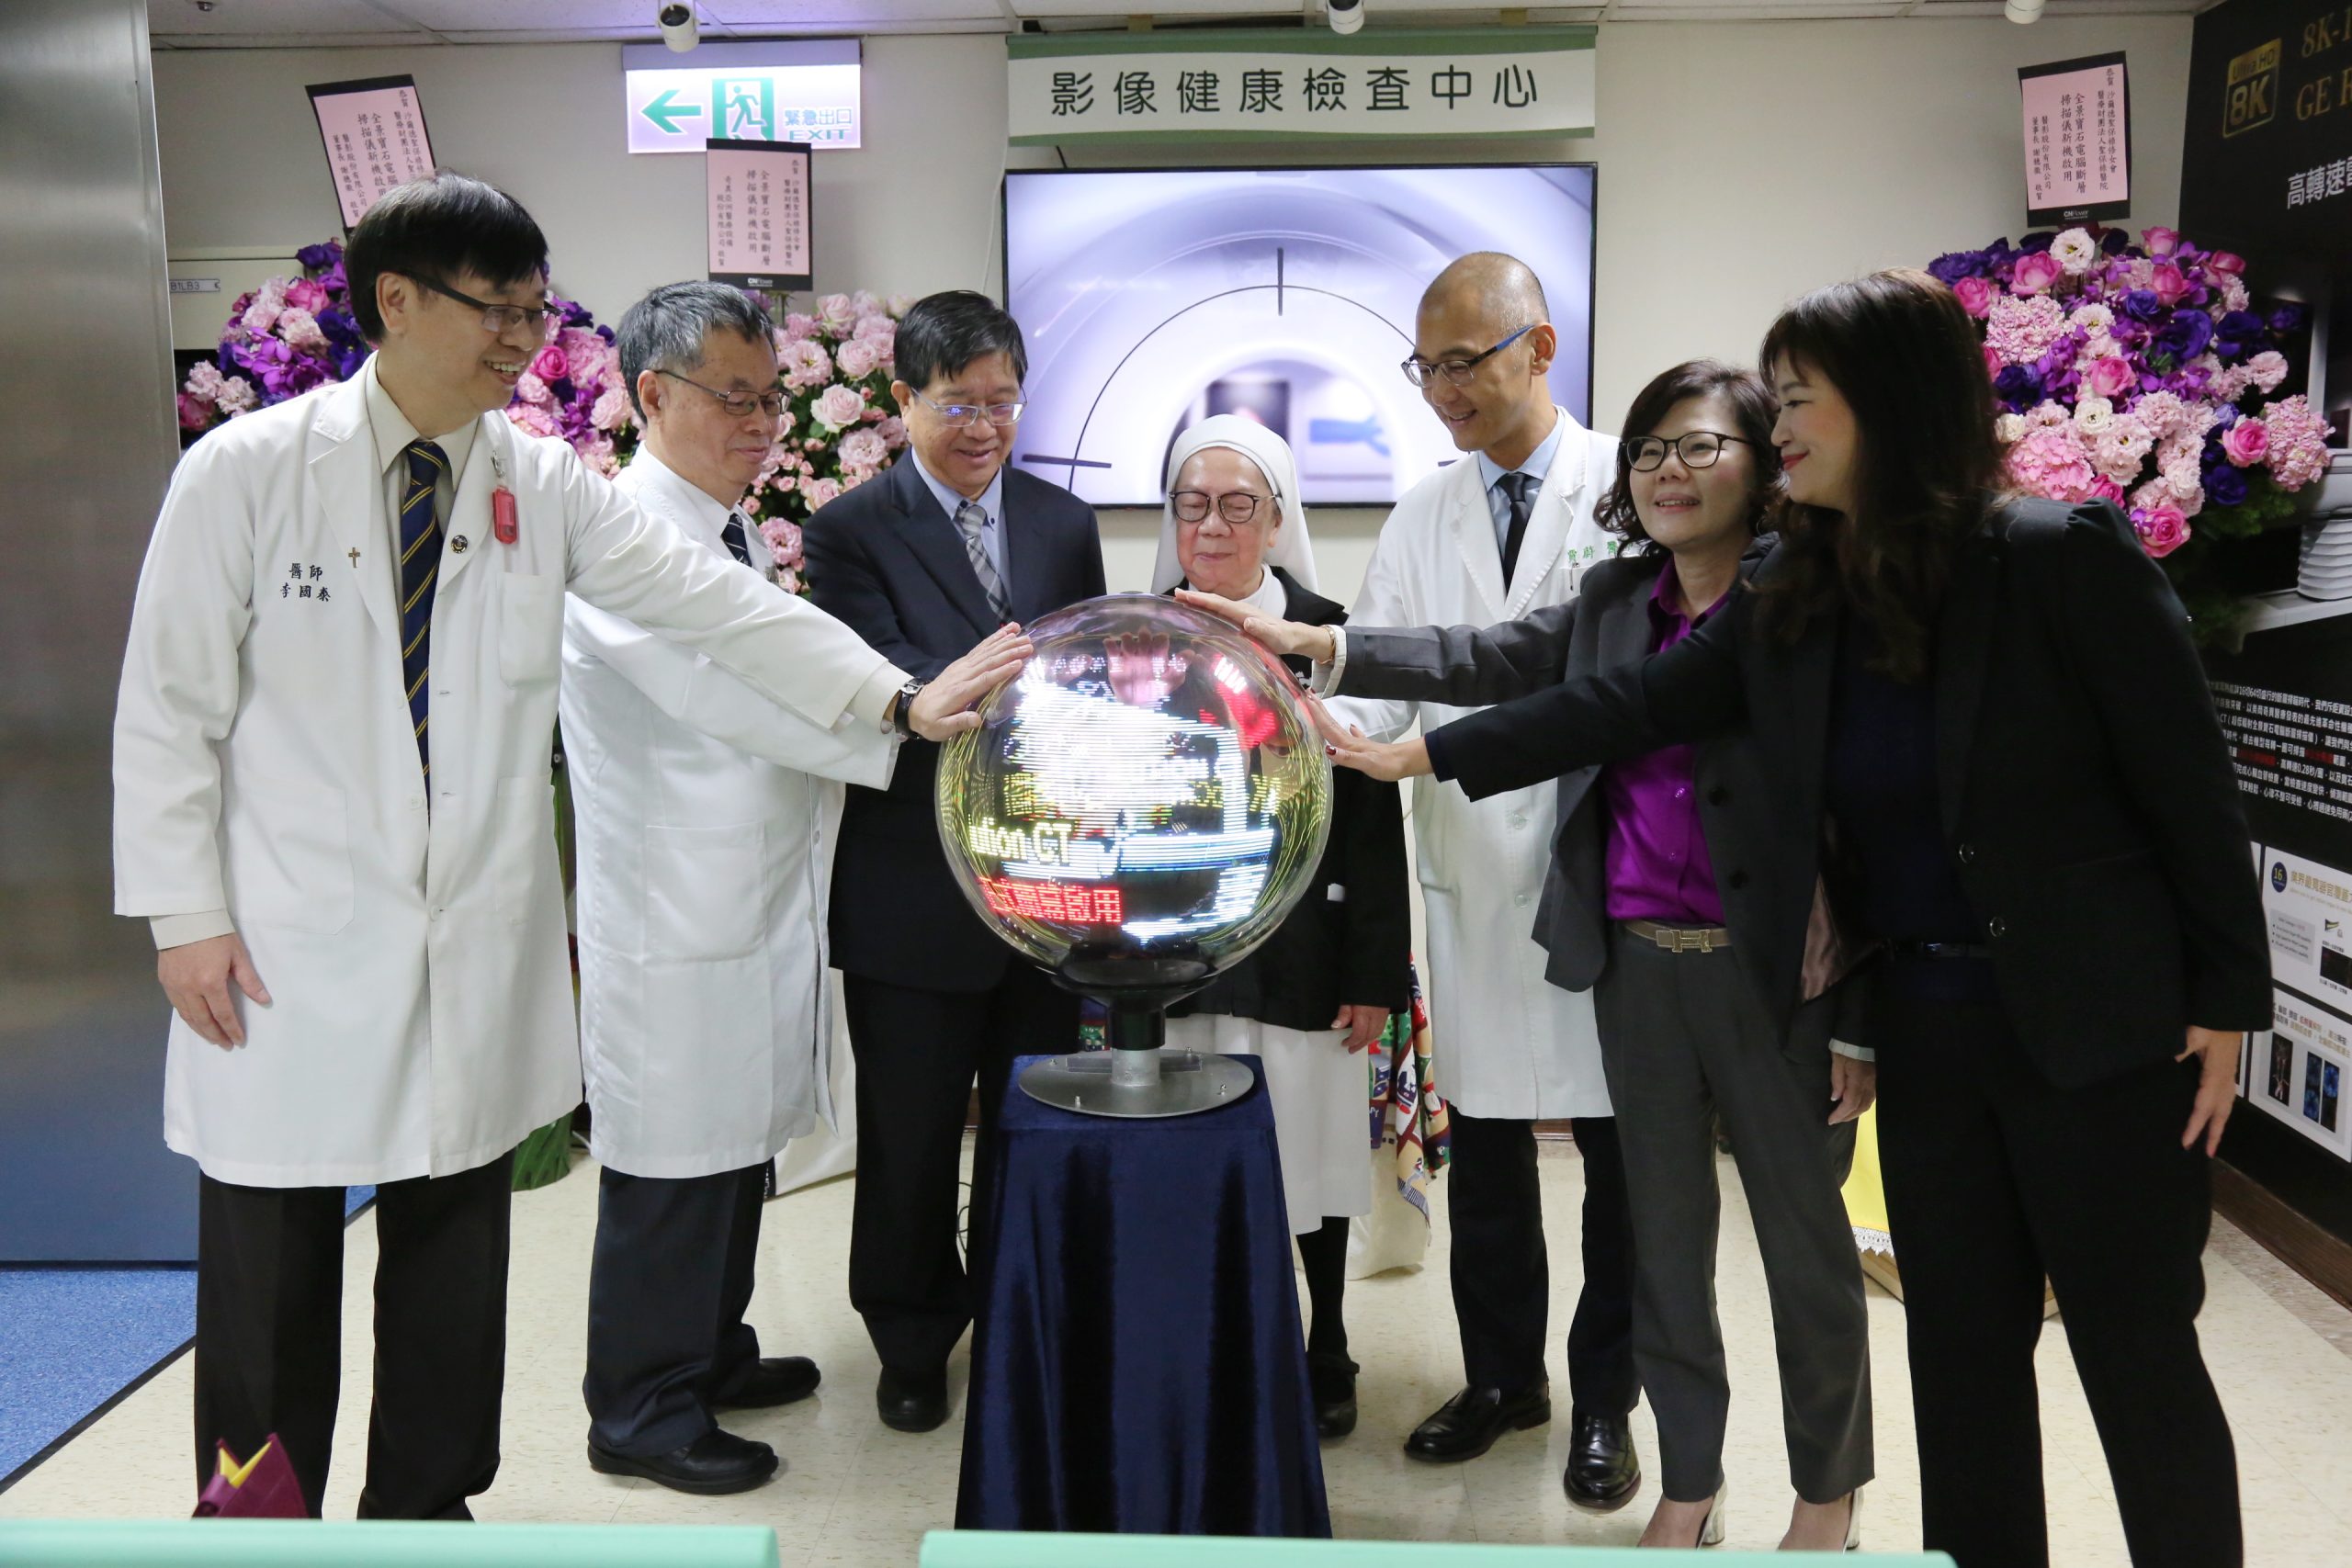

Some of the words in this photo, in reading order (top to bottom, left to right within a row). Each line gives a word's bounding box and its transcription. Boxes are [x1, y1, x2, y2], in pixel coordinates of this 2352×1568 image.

[2301, 7, 2352, 58] 8K-
[2258, 48, 2276, 68] HD
[1050, 64, 1538, 116] 影像健康檢查中心
[2230, 74, 2270, 126] 8K
[2296, 75, 2332, 120] GE
[785, 108, 852, 126] 緊急出口
[789, 130, 850, 141] EXIT
[288, 562, 323, 581] 醫師
[2274, 867, 2283, 881] 16
